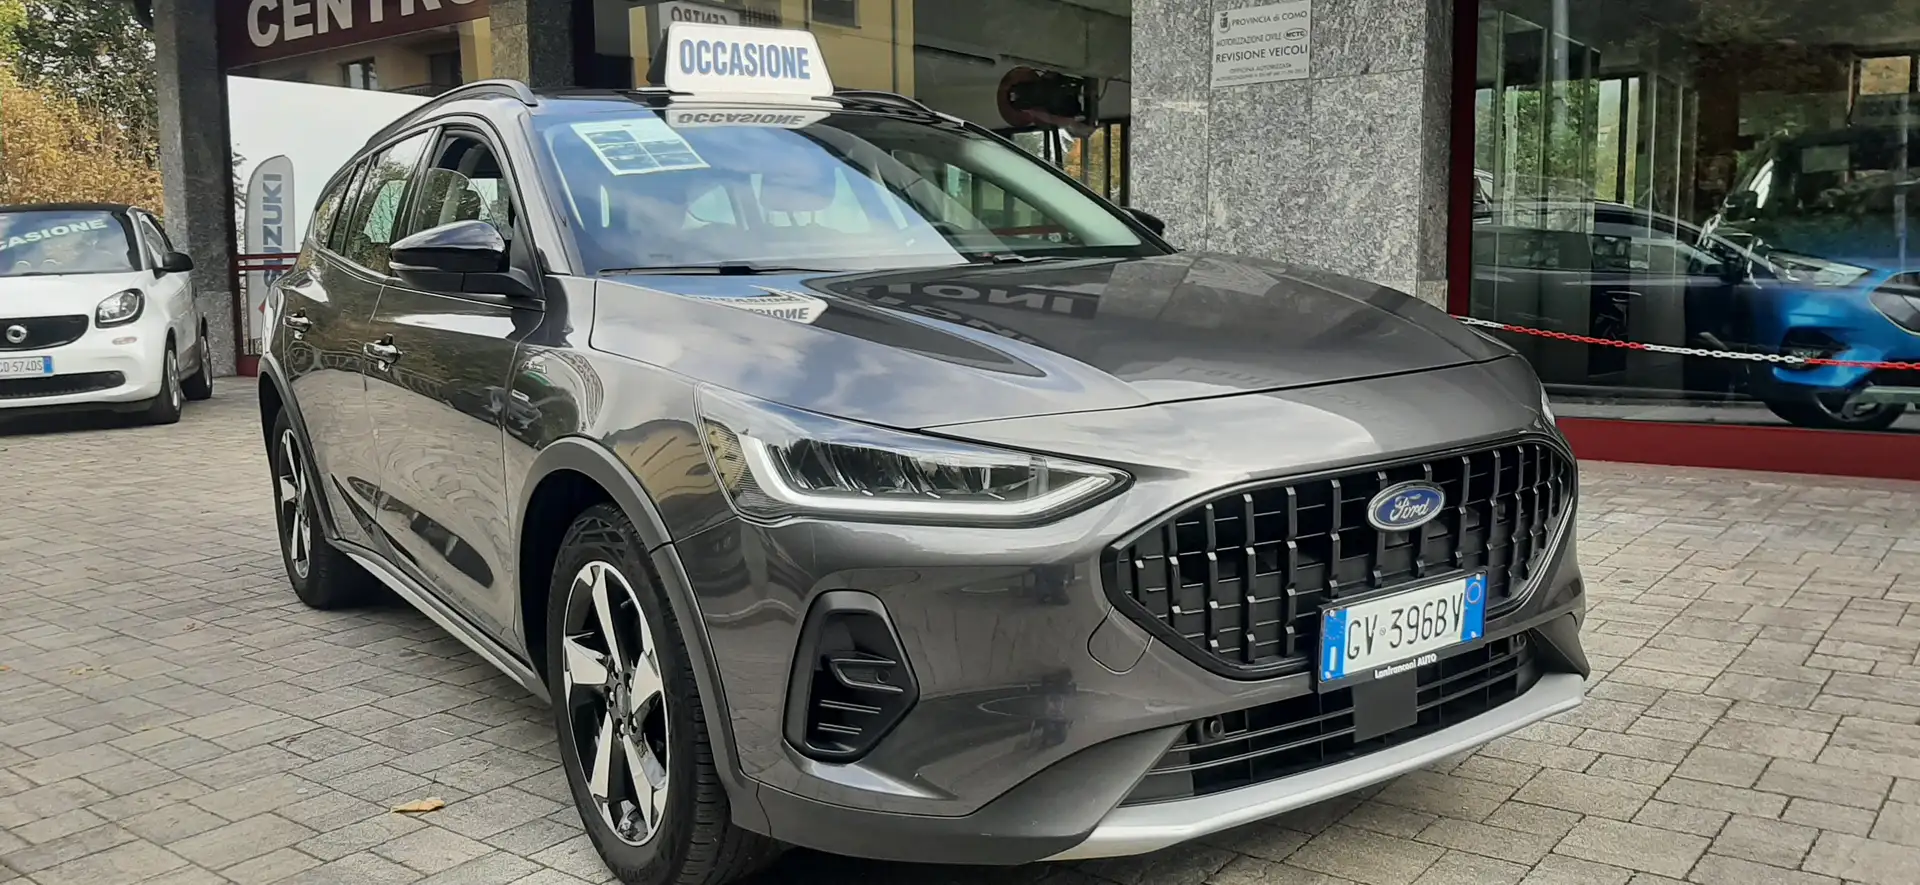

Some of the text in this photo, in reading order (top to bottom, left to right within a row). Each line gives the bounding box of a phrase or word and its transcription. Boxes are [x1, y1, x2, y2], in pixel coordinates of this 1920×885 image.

[1232, 16, 1271, 26] PROVINCIA
[1282, 10, 1308, 20] COMO
[1286, 30, 1306, 38] MCTC
[680, 39, 810, 80] OCCASIONE
[1216, 44, 1308, 62] REVISIONE VEICOLI
[263, 173, 283, 288] SUZUKI
[1390, 495, 1430, 521] Ford
[1347, 614, 1378, 660] GV
[1389, 593, 1463, 649] 396BV
[1375, 653, 1437, 679] Lanfranconi AUTO
